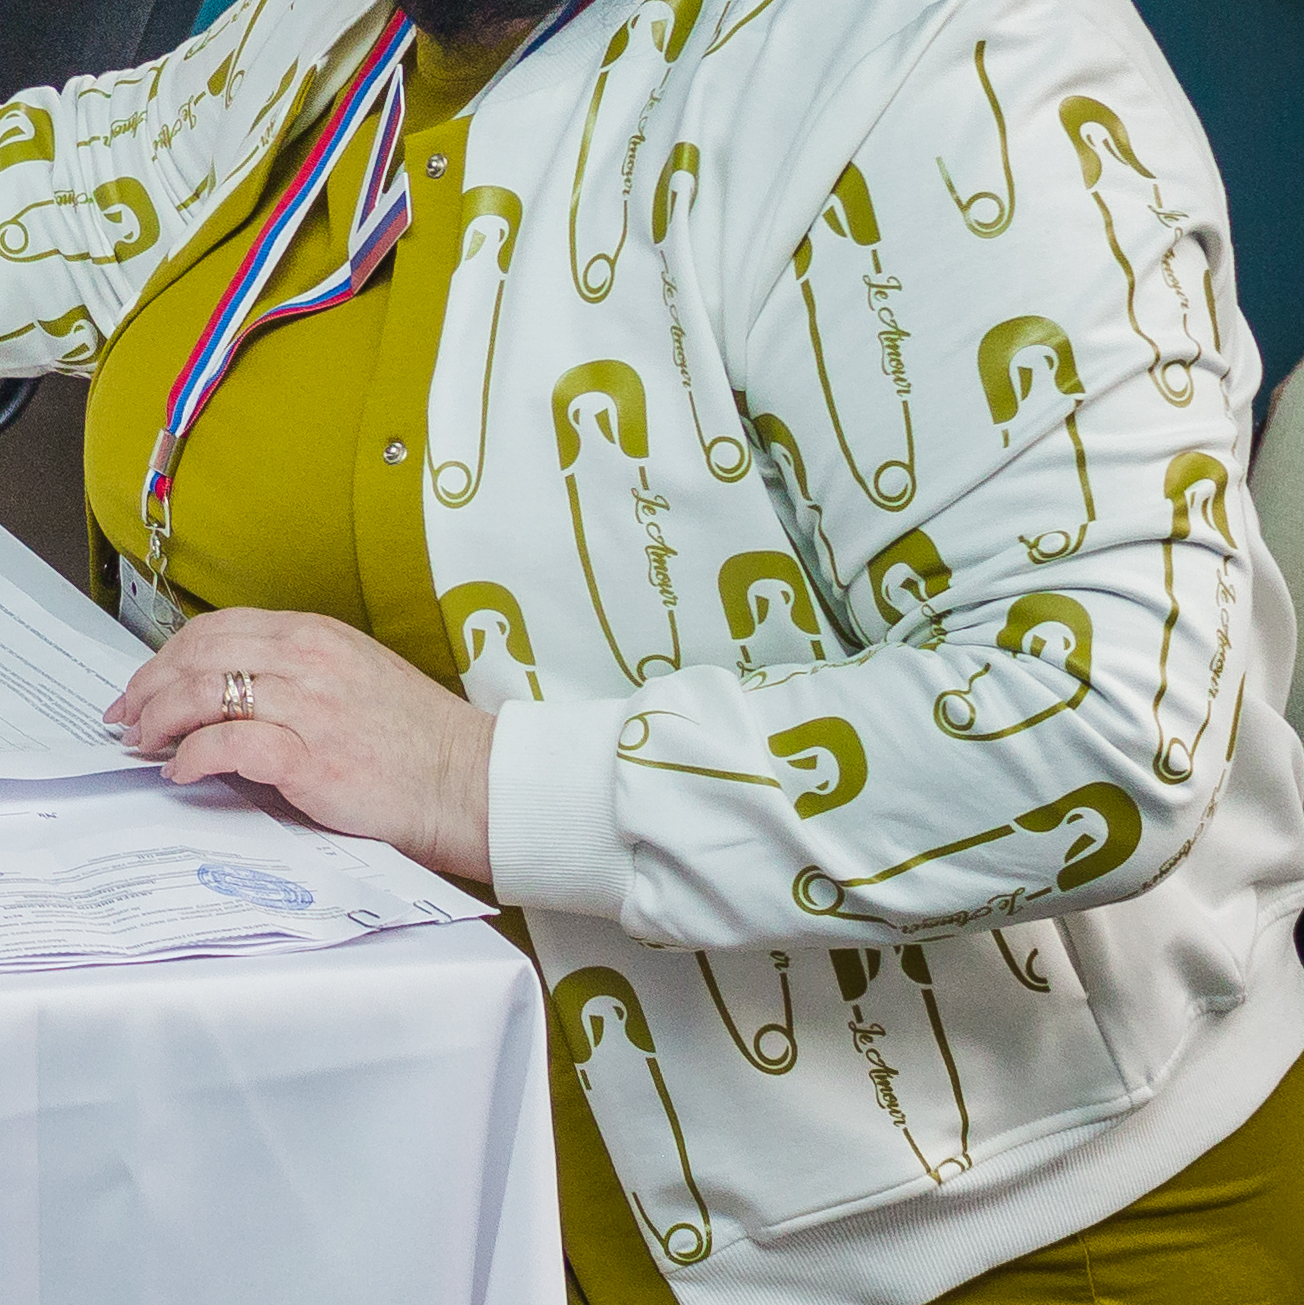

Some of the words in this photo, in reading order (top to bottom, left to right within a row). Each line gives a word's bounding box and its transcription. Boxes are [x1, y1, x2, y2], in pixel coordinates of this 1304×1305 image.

[877, 306, 914, 398] Amour
[645, 521, 679, 608] Amour
[865, 1046, 908, 1128] Amour
